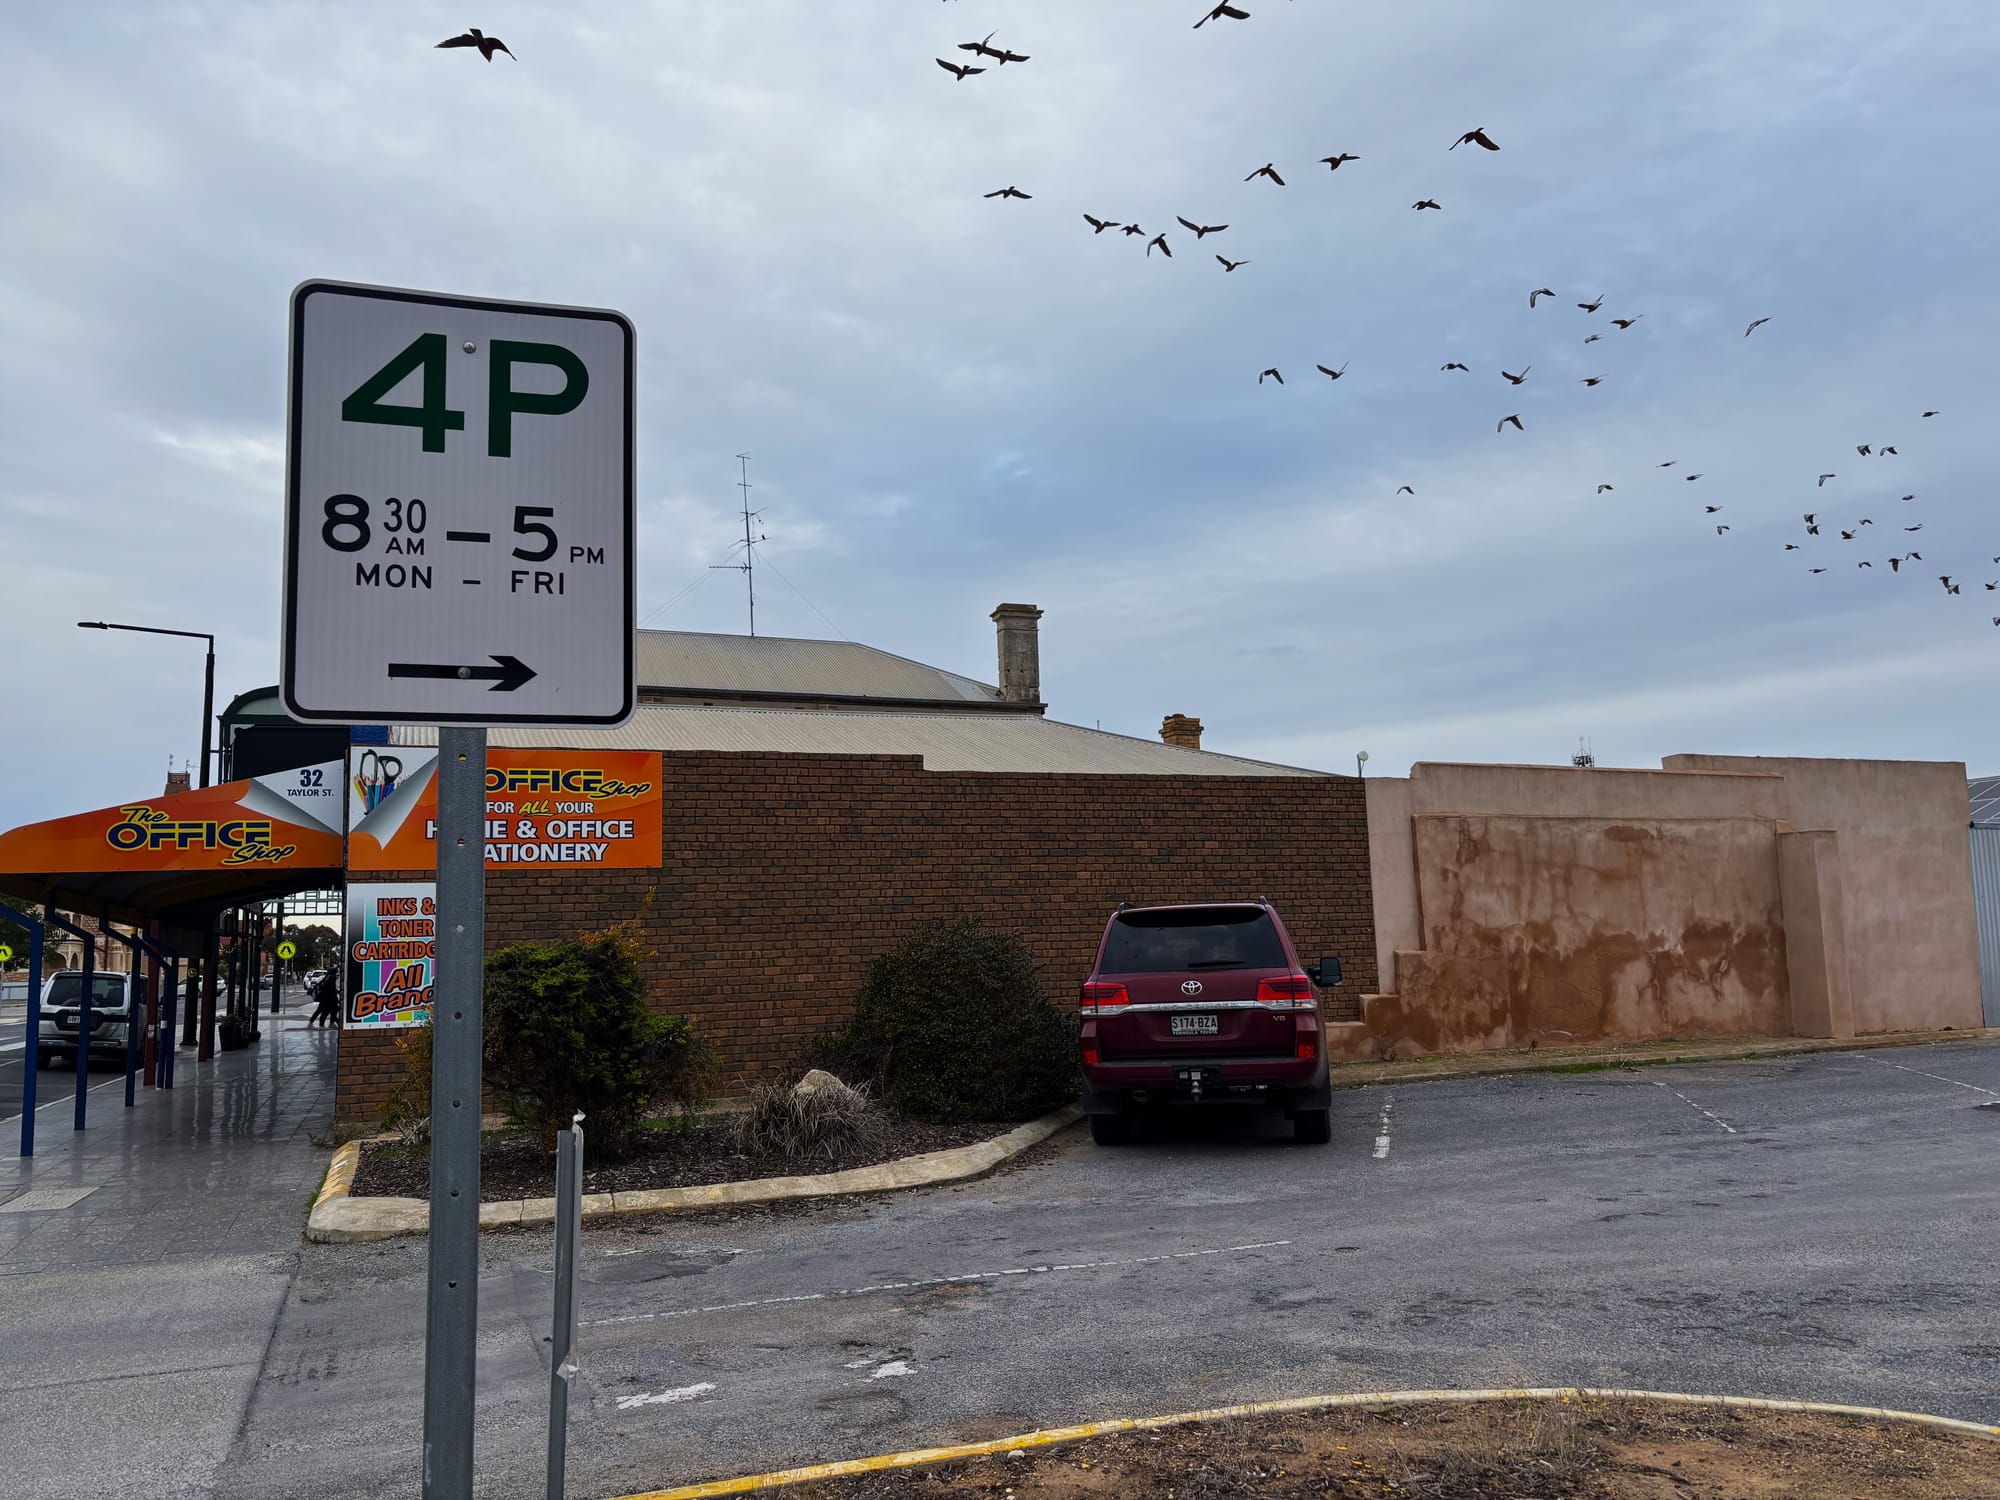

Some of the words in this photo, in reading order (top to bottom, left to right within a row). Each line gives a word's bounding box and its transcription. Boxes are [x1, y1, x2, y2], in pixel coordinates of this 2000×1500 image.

[341, 332, 589, 458] 4P
[321, 493, 371, 552] 8
[383, 497, 427, 534] 30
[511, 505, 558, 562] 5
[569, 546, 604, 565] PM
[385, 536, 425, 556] AM
[355, 562, 432, 590] MON
[511, 570, 565, 595] FRI
[300, 769, 323, 787] 32
[486, 769, 603, 792] OFFICE
[589, 780, 651, 799] Shop
[286, 788, 320, 797] TAYLOR
[322, 788, 335, 797] ST.
[121, 807, 168, 822] The
[486, 801, 514, 814] FOR
[518, 799, 551, 815] ALL
[556, 802, 594, 814] YOUR
[107, 821, 271, 850] OFFICE
[517, 820, 538, 838] &
[546, 820, 634, 838] OFFICE
[222, 842, 296, 865] Shop
[485, 843, 608, 862] ATIONERY
[377, 897, 418, 916] INKS
[421, 897, 436, 915] &
[379, 919, 434, 938] TONER
[353, 941, 436, 961] CARTRIDG
[385, 964, 424, 993] All
[354, 977, 435, 1018] Brand
